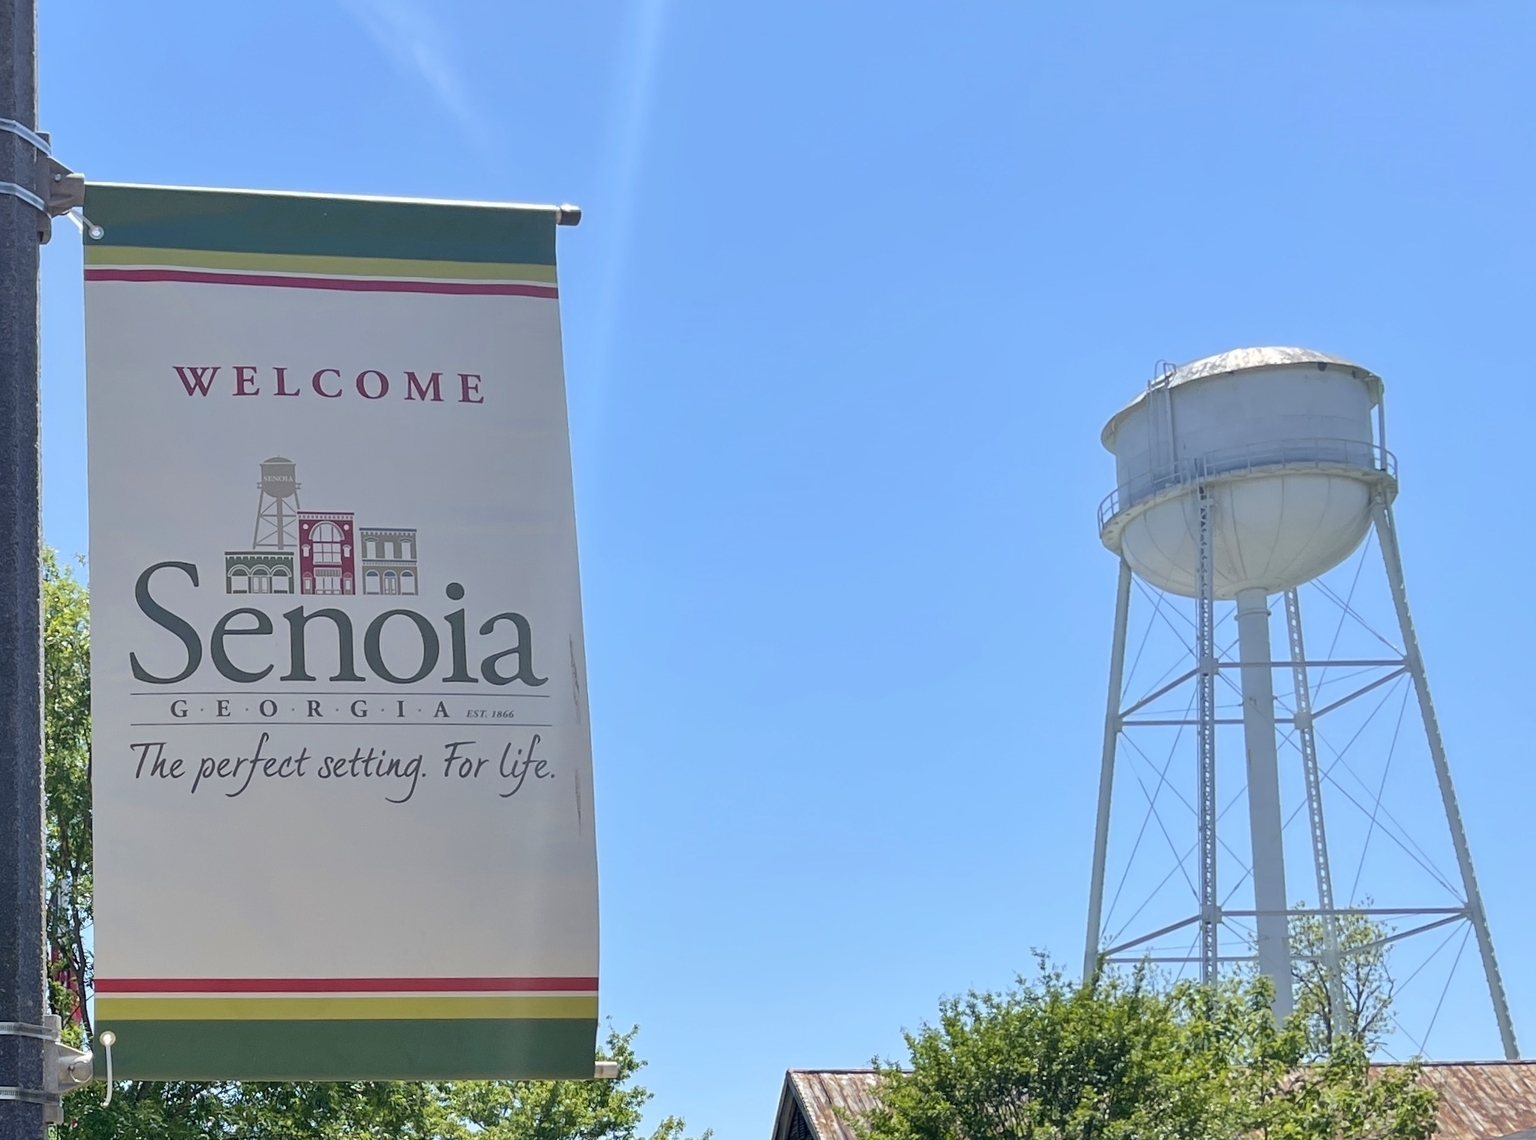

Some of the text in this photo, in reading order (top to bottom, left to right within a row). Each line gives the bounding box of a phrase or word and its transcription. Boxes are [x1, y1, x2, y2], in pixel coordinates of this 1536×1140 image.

[172, 364, 486, 404] WELCOME
[262, 474, 295, 484] SENOIA
[129, 560, 550, 688] Senoia
[465, 708, 516, 720] EST. 1866
[129, 731, 557, 804] The perfect setting. For life.
